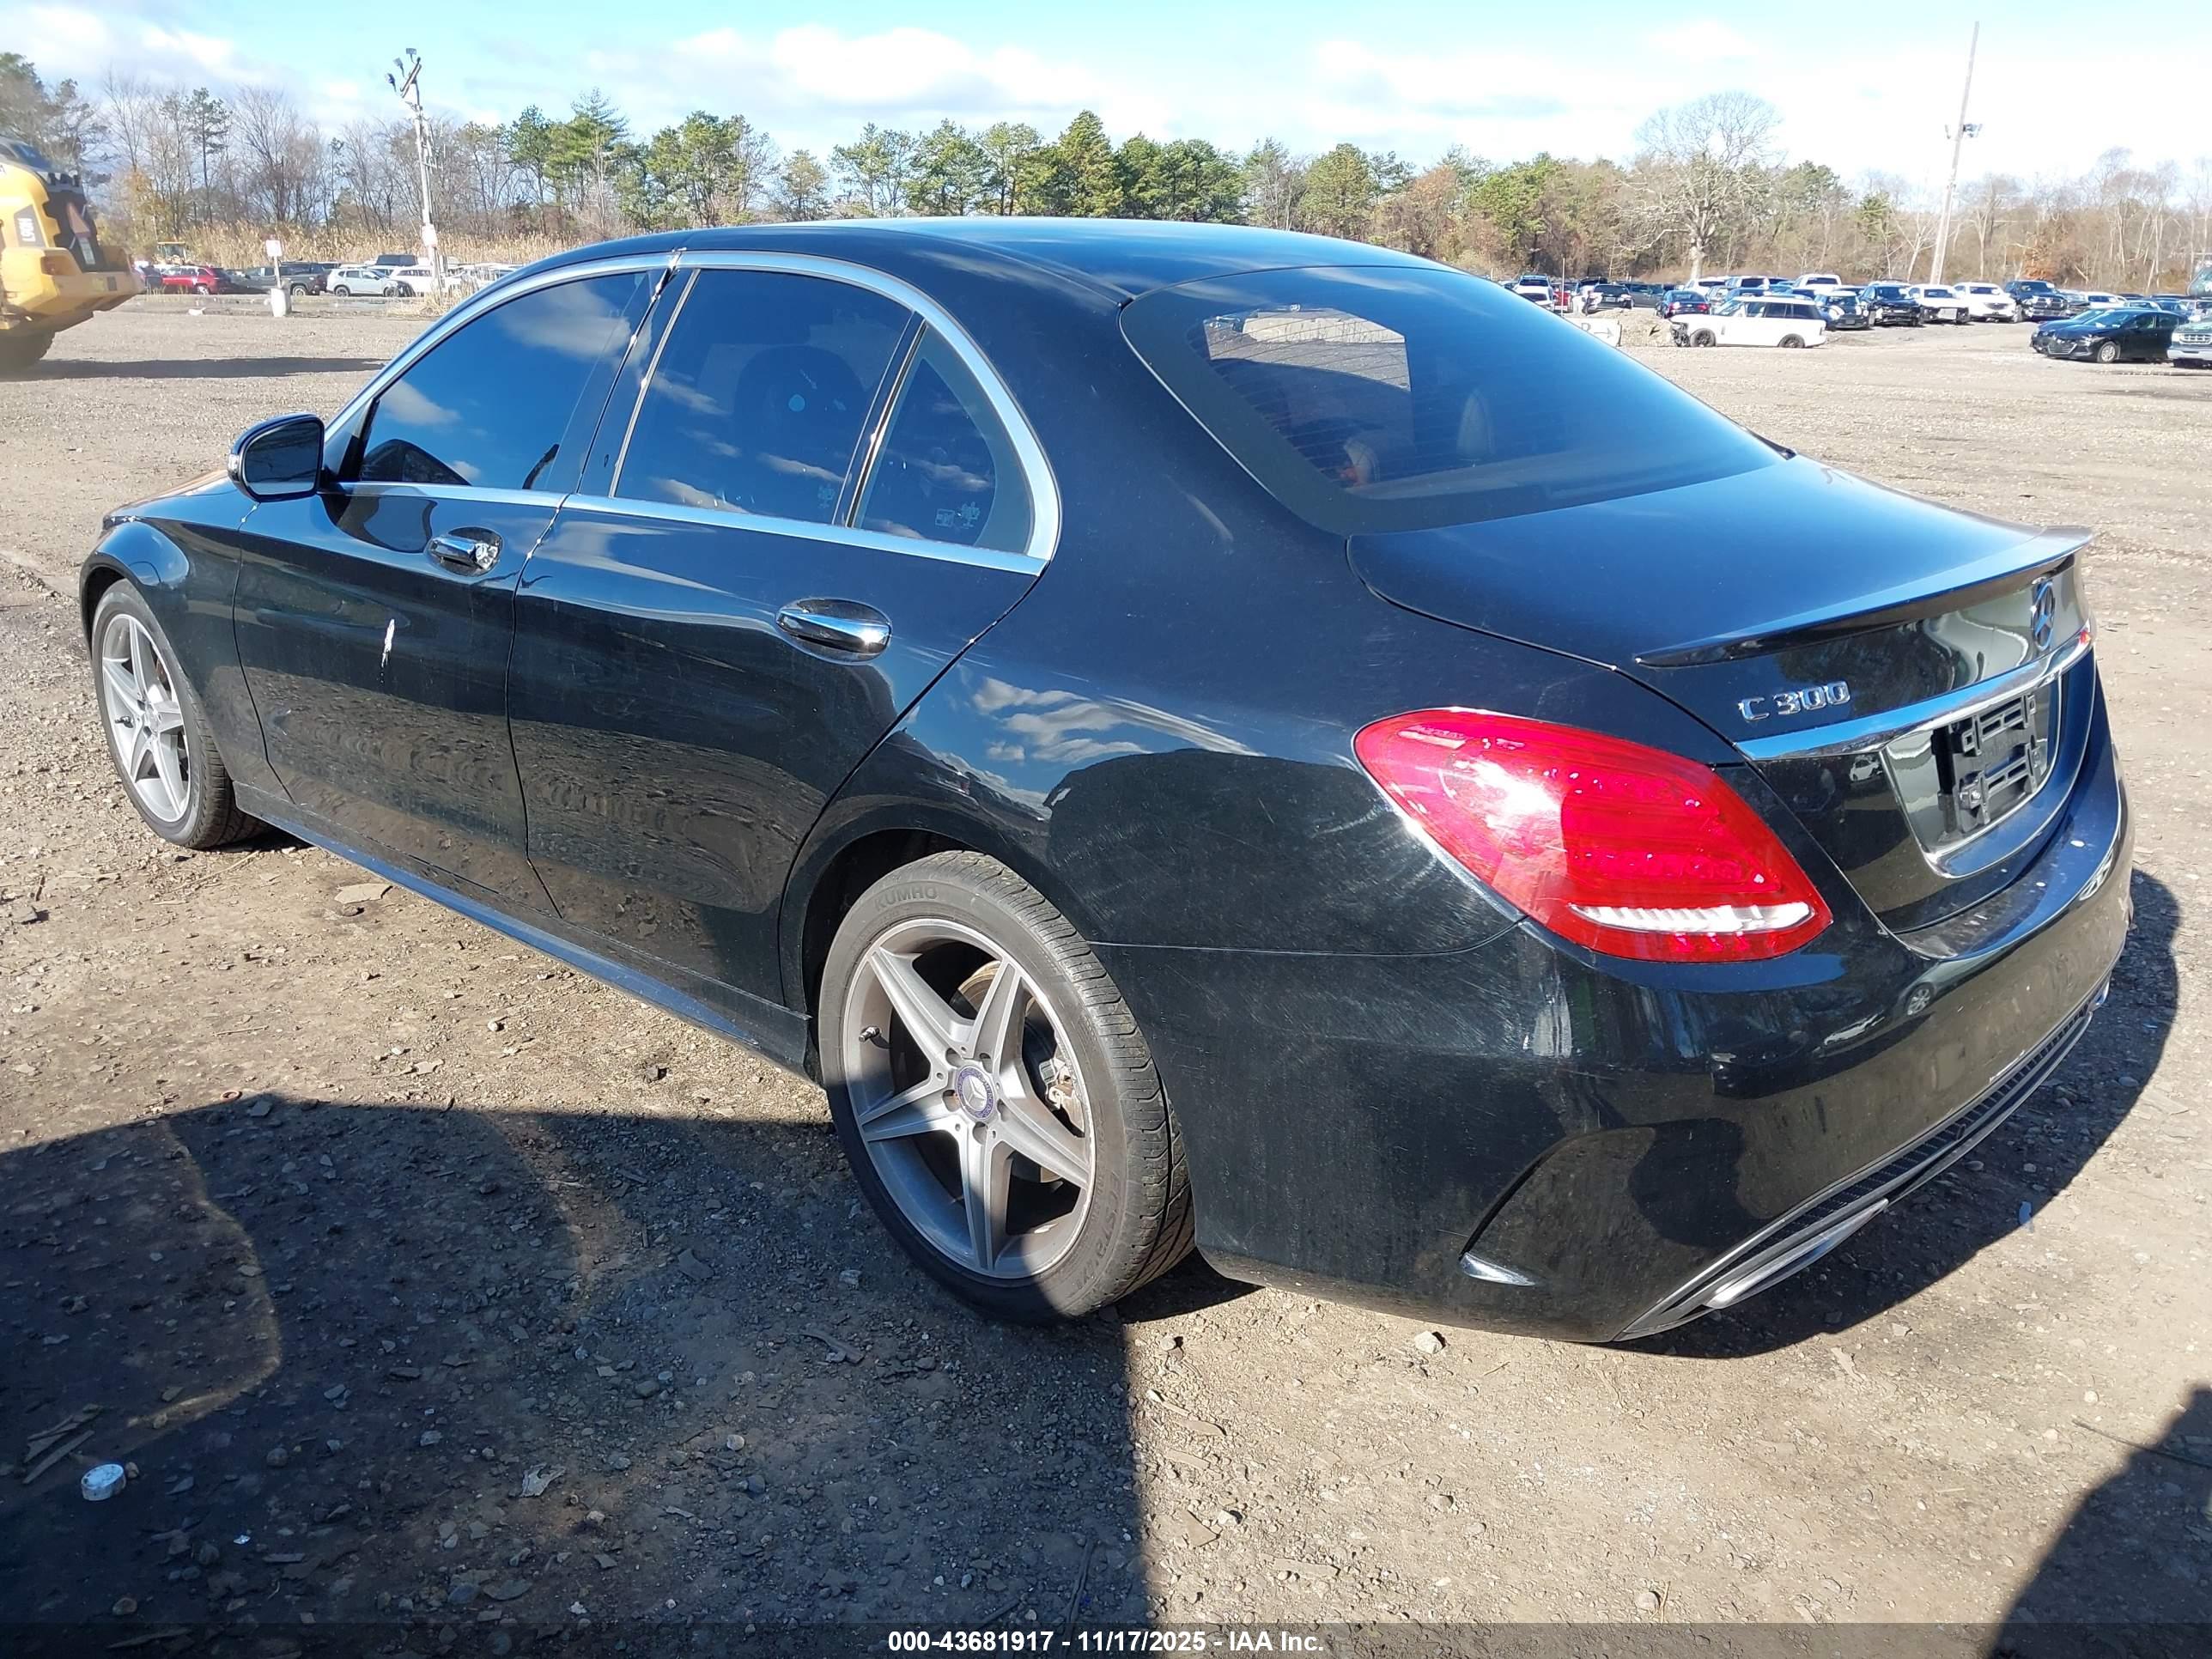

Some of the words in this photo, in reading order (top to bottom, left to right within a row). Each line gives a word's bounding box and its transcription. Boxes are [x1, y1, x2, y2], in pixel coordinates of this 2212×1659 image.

[1738, 697, 1770, 720] C
[1772, 681, 1850, 714] 300
[874, 885, 939, 911] KUMHO
